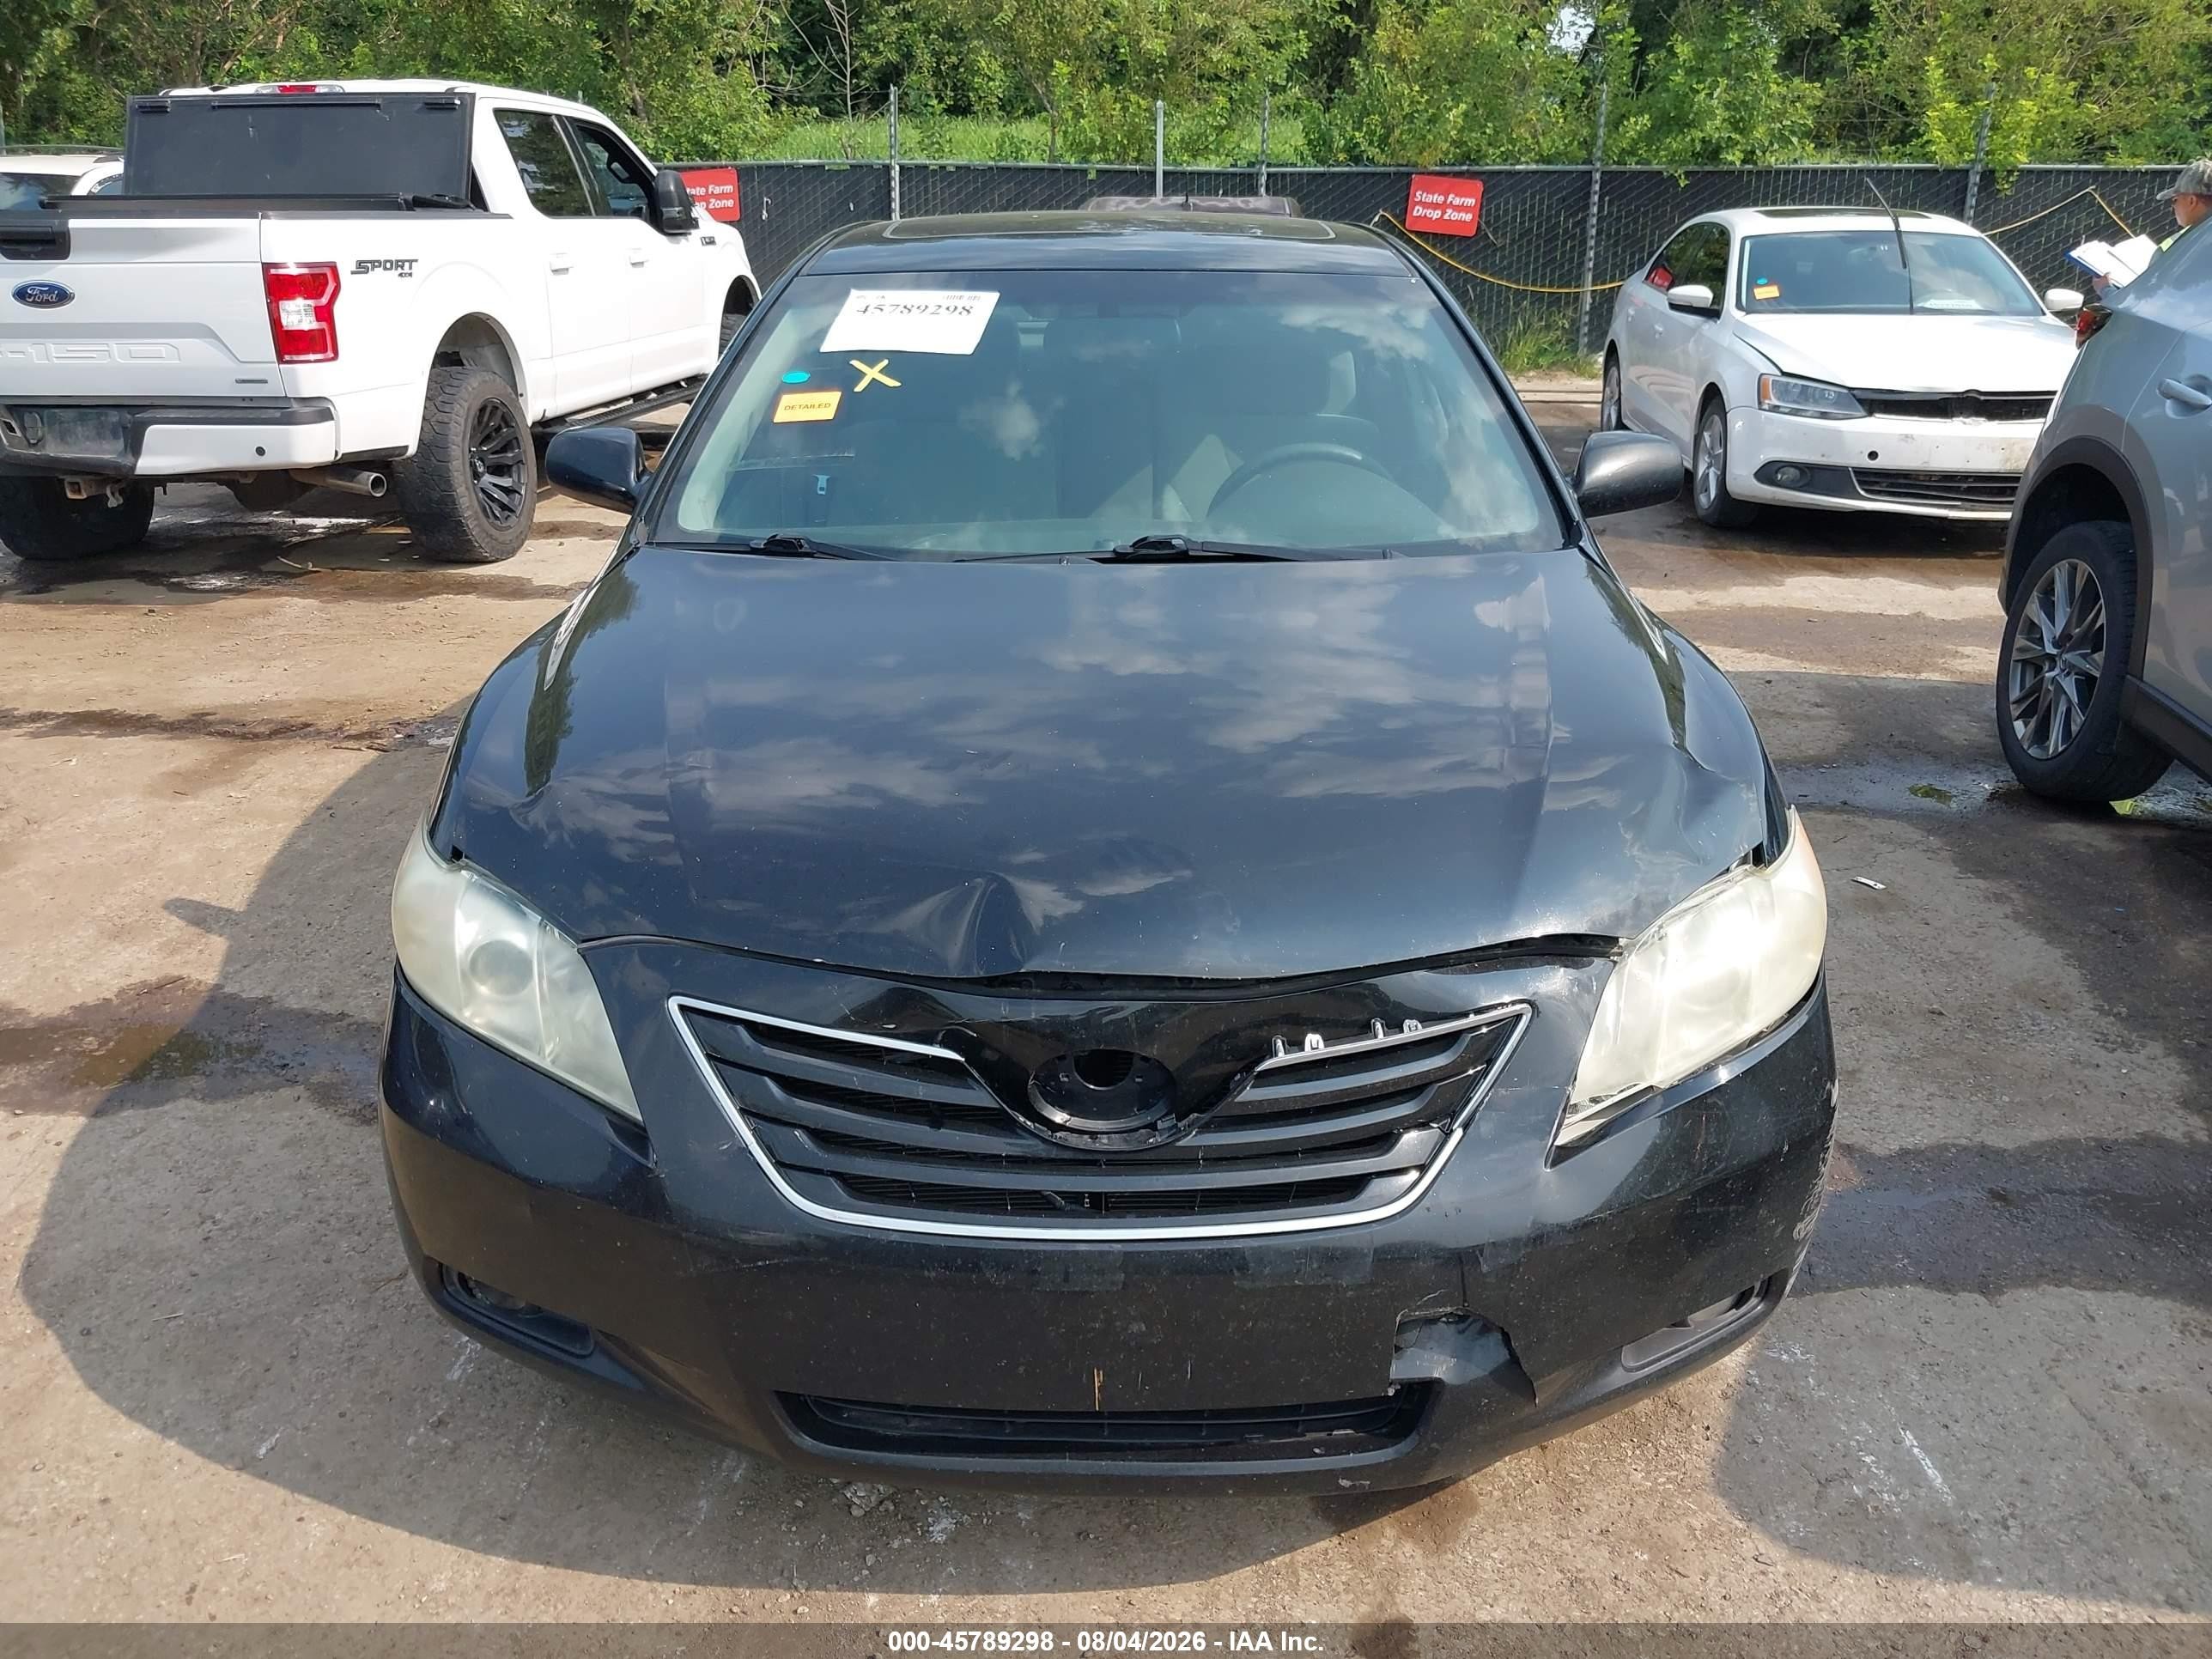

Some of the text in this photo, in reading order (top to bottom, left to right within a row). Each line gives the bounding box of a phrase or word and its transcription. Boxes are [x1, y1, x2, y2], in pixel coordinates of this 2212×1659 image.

[687, 185, 733, 196] tate Farm
[708, 198, 734, 209] Zone
[1414, 191, 1476, 206] State Farm
[1413, 205, 1473, 222] Drop Zone
[350, 258, 418, 275] SPORT
[26, 286, 58, 302] Ford
[857, 303, 974, 316] 45789298
[0, 343, 181, 363] -150
